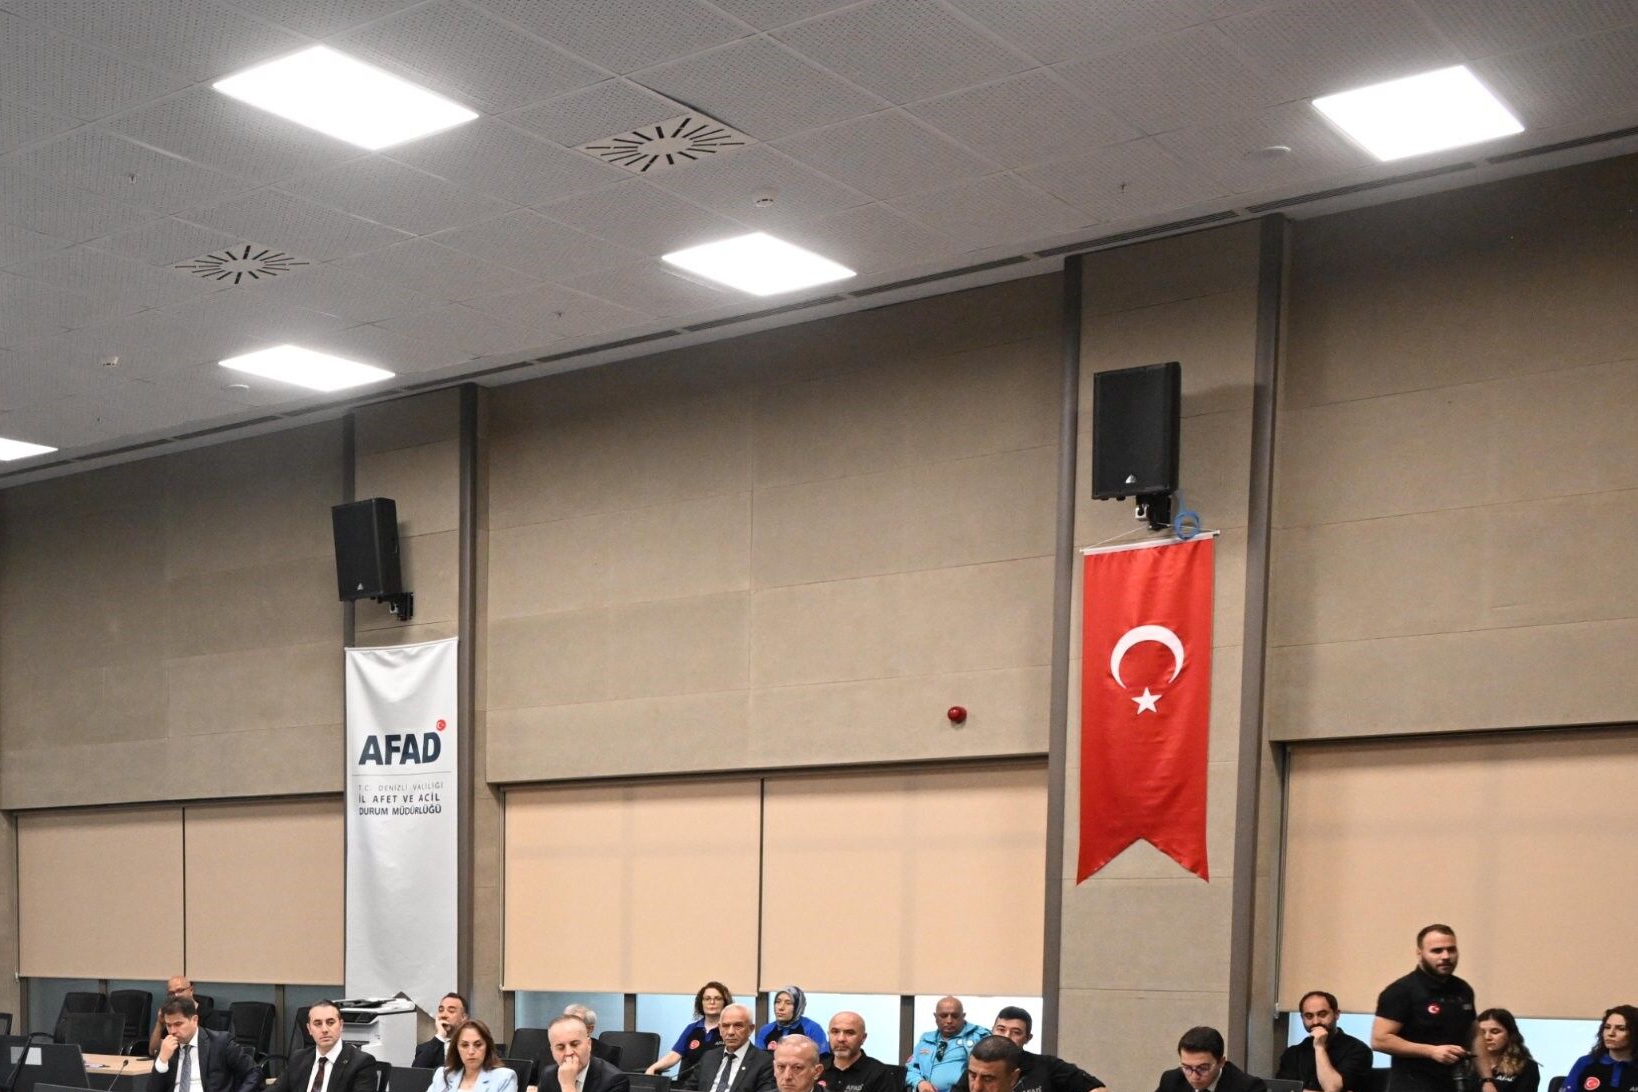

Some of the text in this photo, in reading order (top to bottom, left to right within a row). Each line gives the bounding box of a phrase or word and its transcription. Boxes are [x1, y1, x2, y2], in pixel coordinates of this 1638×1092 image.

[358, 731, 442, 766] AFAD
[358, 791, 441, 804] İL AFET VE ACİL
[359, 803, 442, 816] DURUM MÜDÜRLÜĞÜ
